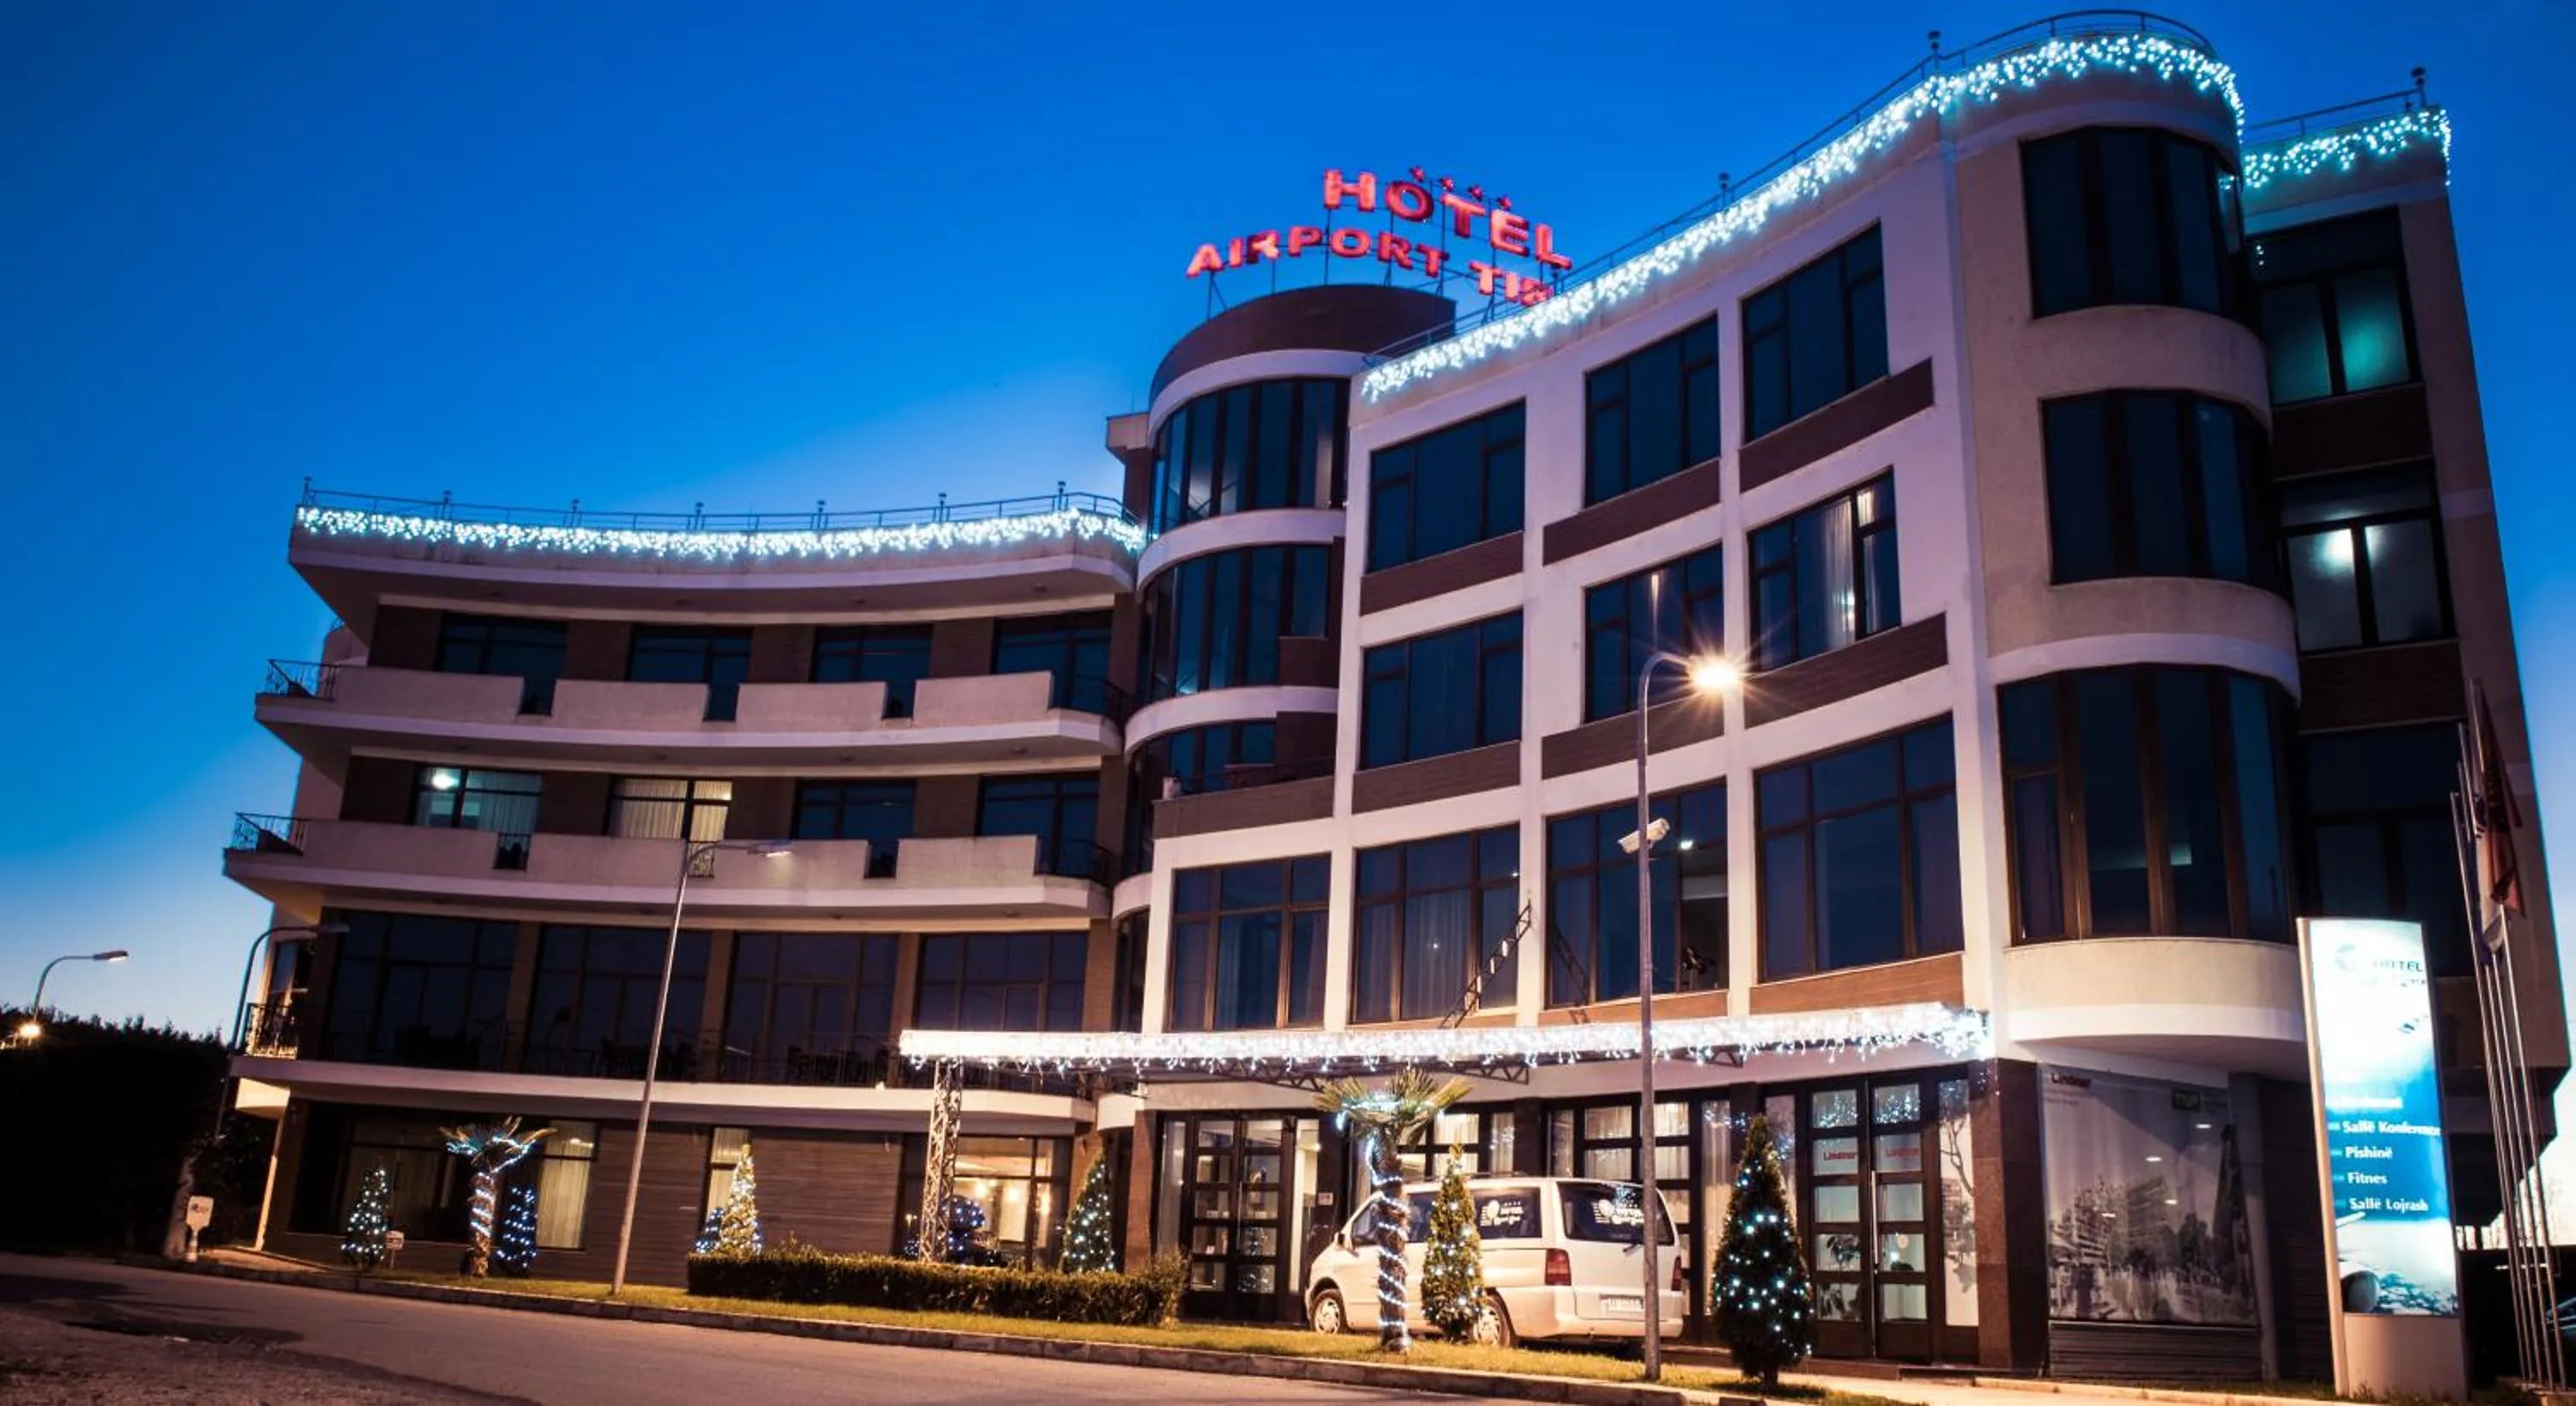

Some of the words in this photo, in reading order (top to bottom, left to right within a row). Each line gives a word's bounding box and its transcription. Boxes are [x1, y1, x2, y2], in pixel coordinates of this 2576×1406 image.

[1323, 168, 1571, 270] HOTEL
[1187, 225, 1449, 278] AIRPORT
[2342, 1119, 2375, 1134] Sallë
[2345, 1146, 2392, 1159] Pishinë
[2348, 1172, 2387, 1185] Fitnes
[2349, 1197, 2381, 1210] Sallë
[2385, 1197, 2428, 1214] Lojrash
